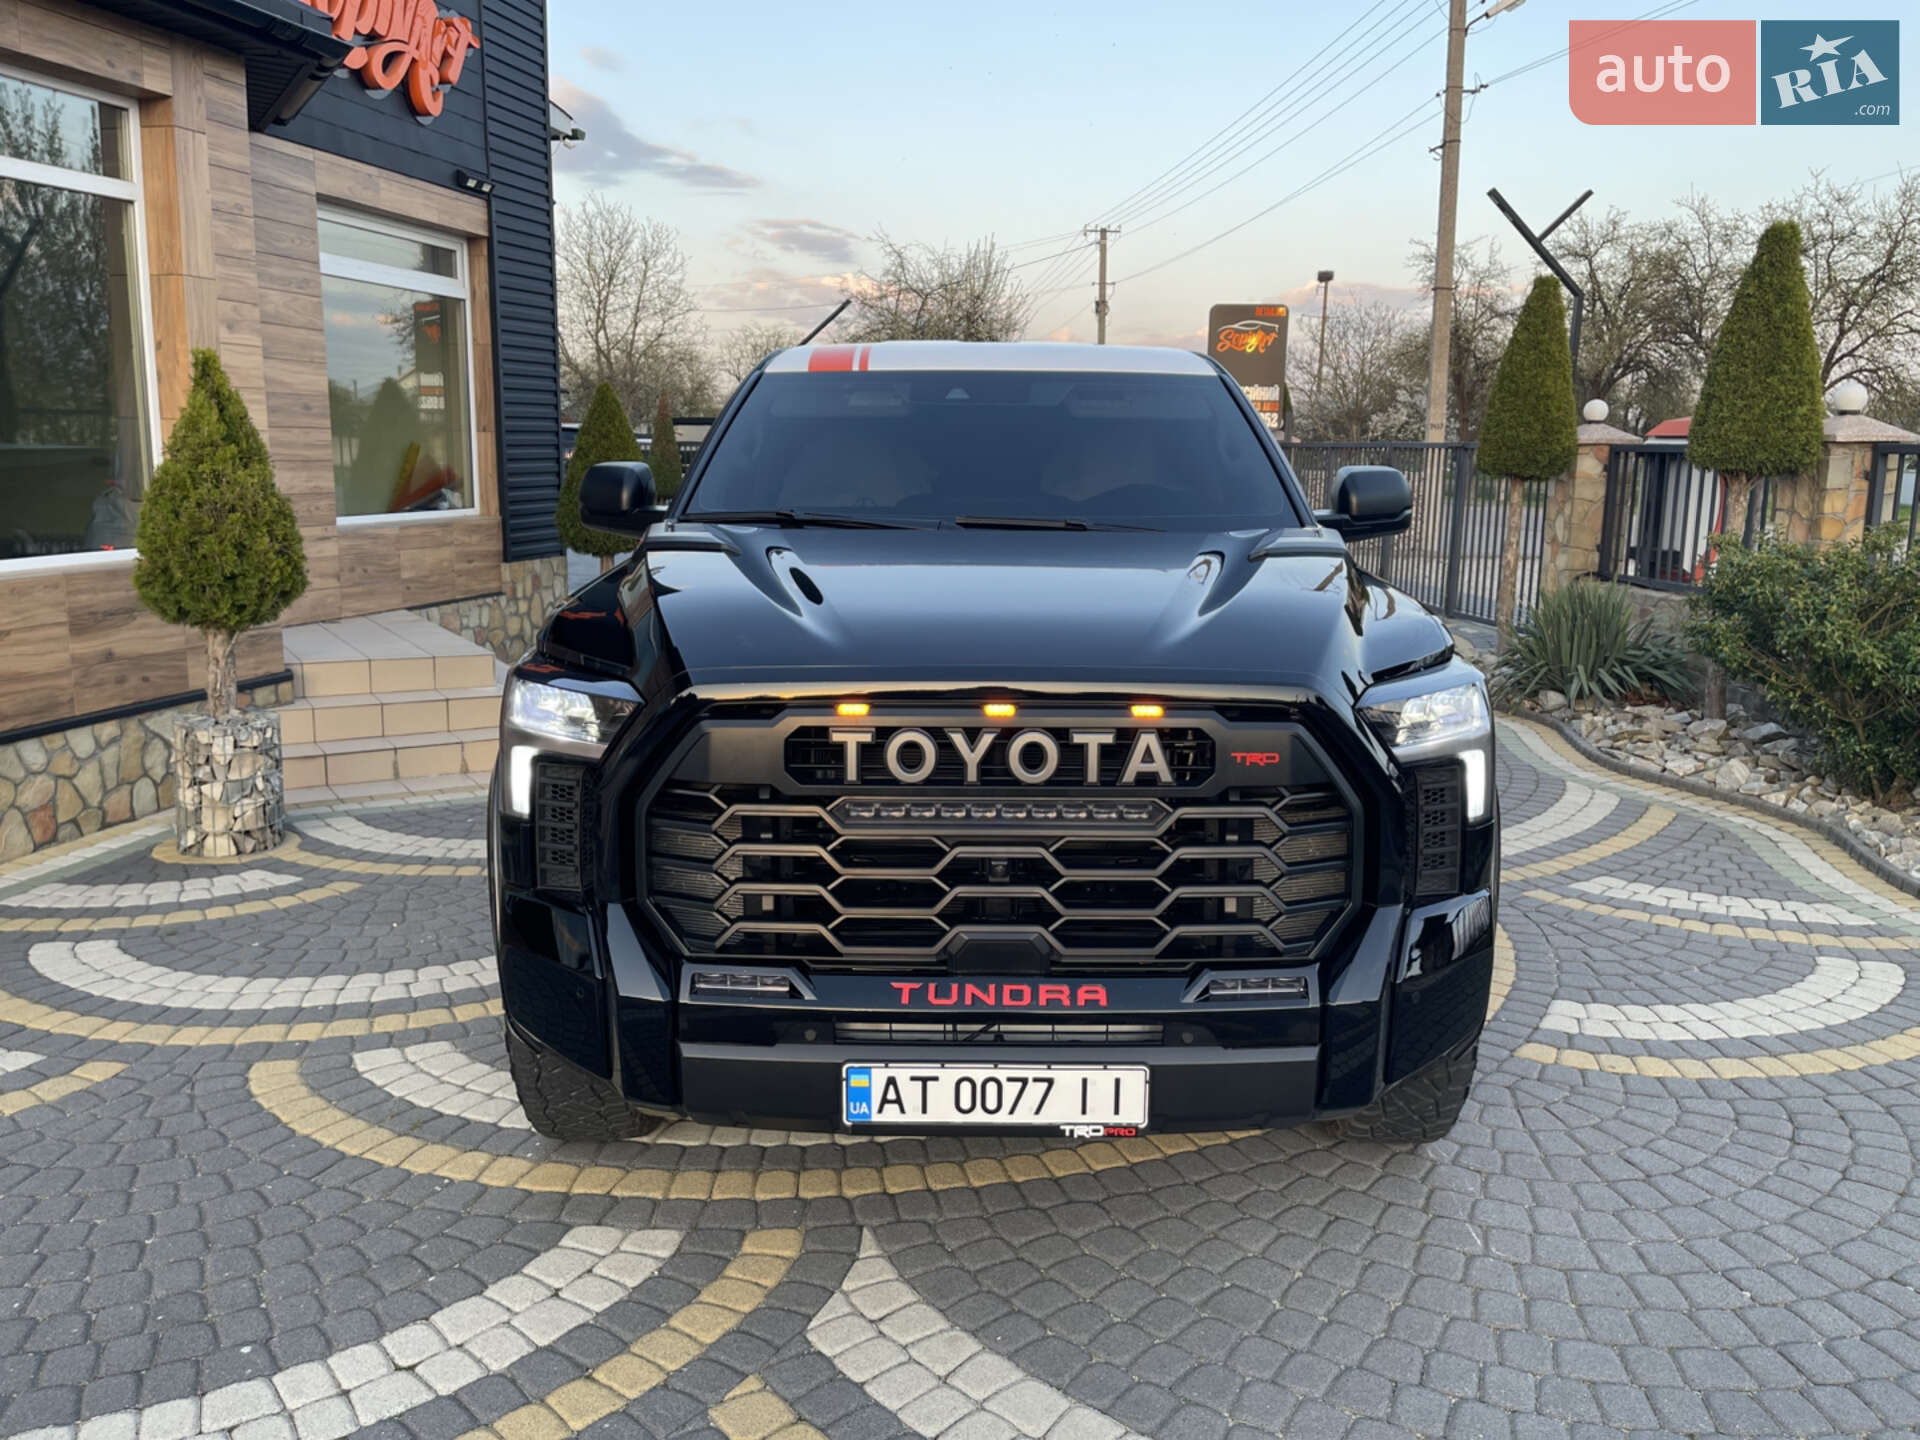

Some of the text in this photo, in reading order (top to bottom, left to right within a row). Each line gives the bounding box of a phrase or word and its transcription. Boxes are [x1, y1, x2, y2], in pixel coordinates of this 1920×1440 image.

[829, 727, 1176, 786] TOYOTA
[1231, 752, 1280, 766] TRD
[889, 981, 1109, 1007] TUNDRA
[850, 1102, 869, 1114] UA
[876, 1076, 939, 1115] AT
[954, 1076, 1055, 1116] 0077
